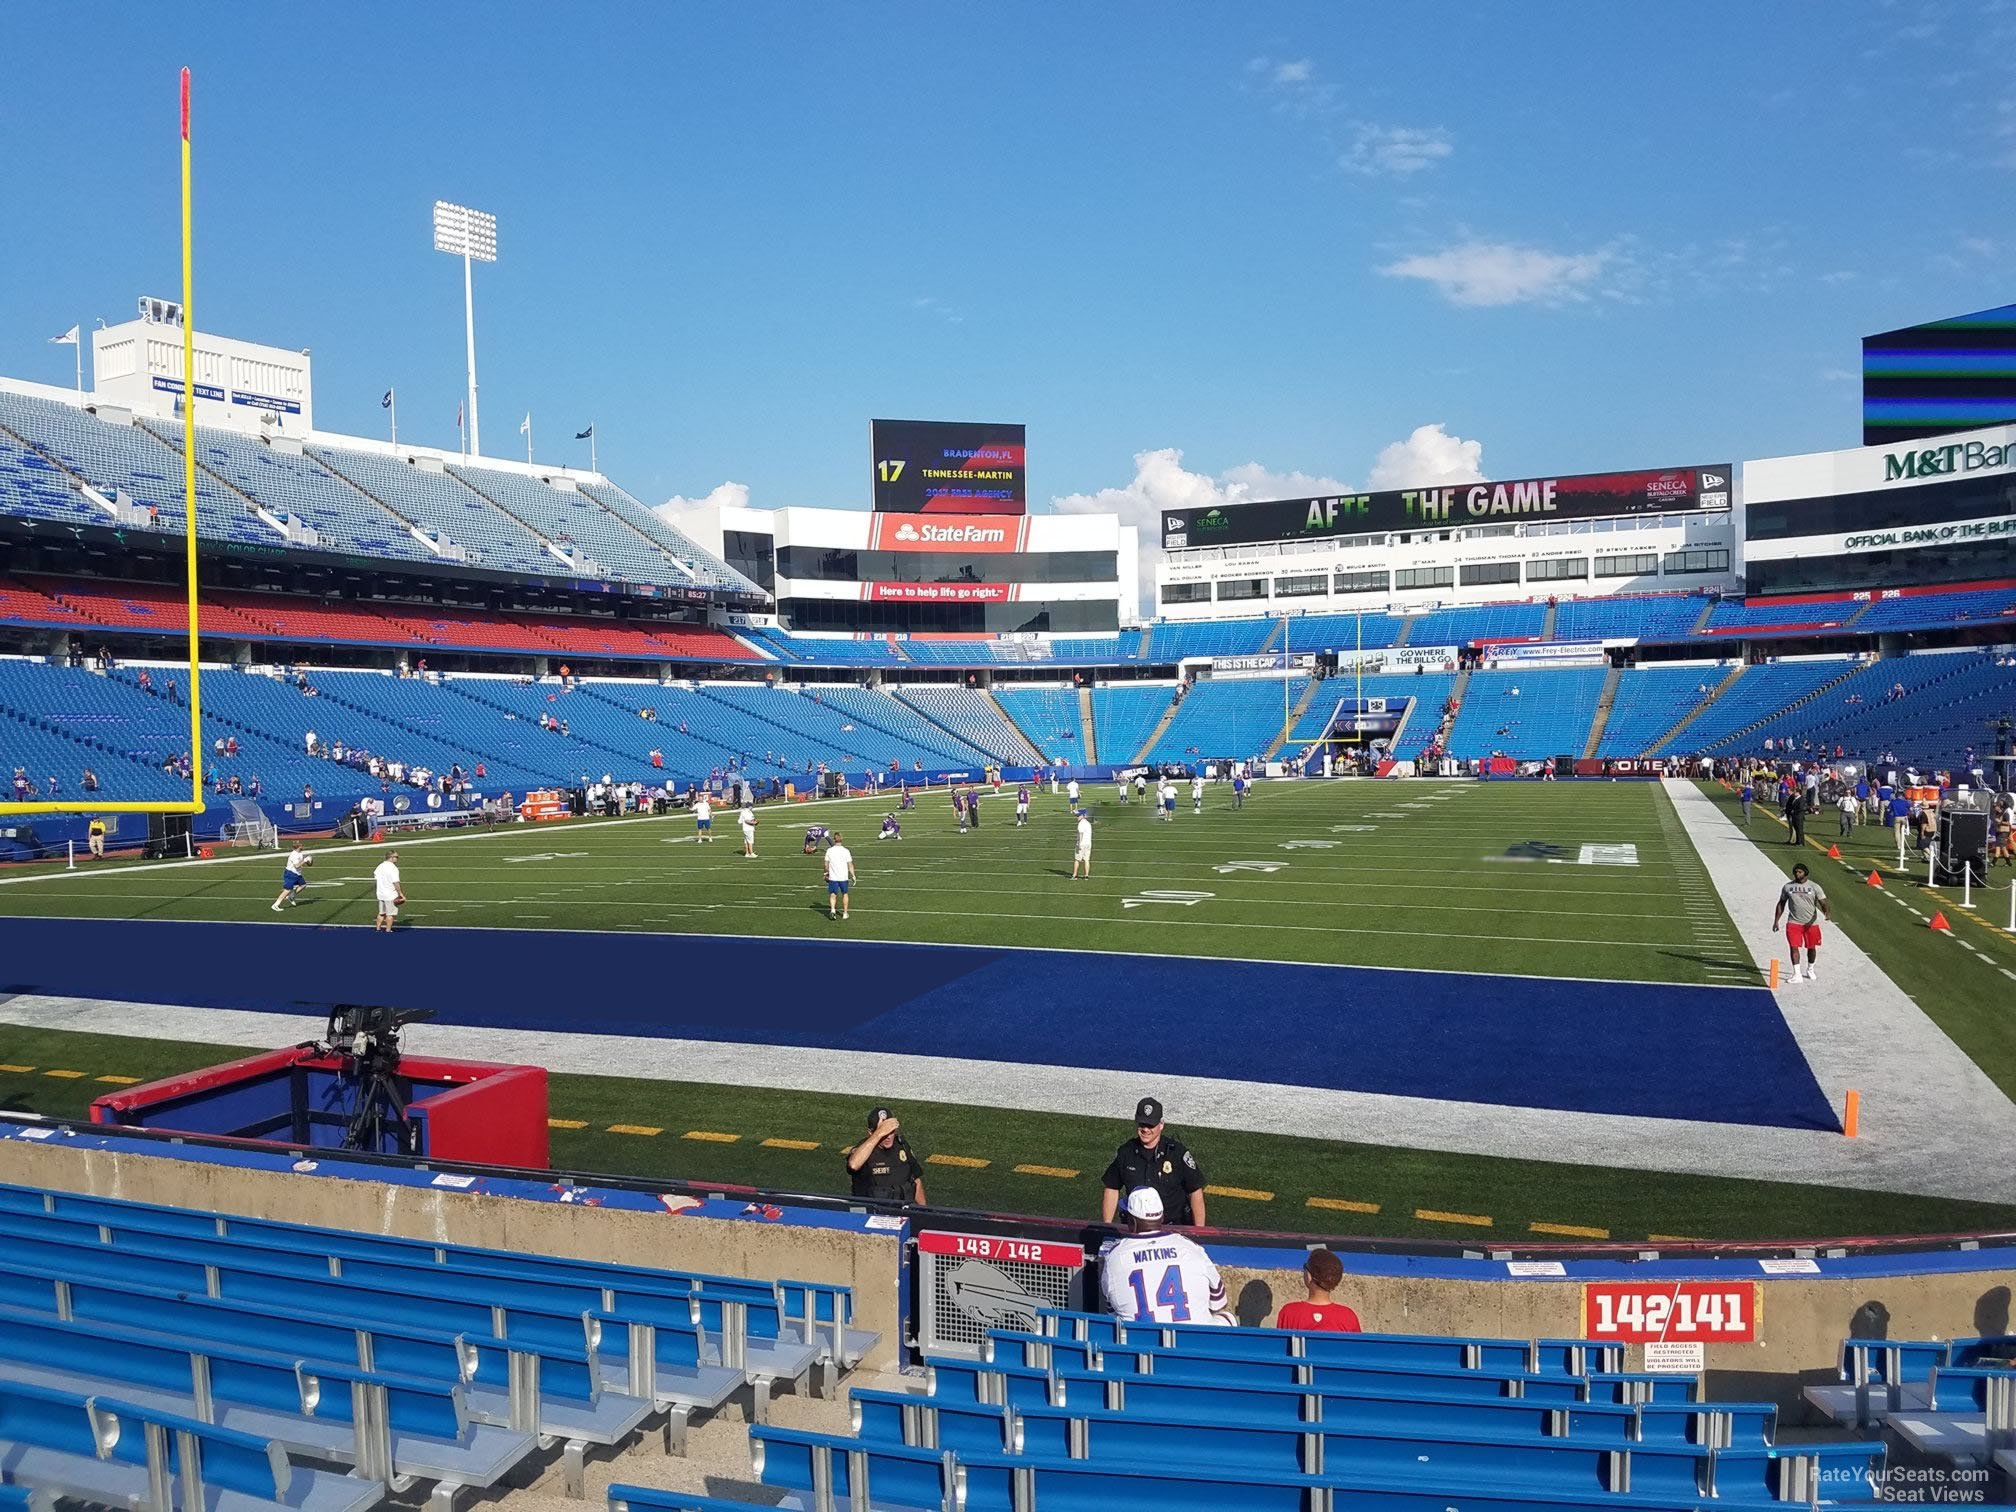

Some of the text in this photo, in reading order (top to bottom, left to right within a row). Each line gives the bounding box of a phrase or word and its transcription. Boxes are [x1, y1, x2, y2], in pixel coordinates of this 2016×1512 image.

[154, 380, 166, 388] FAN
[195, 388, 209, 396] TEXT
[210, 390, 224, 398] LINE
[878, 460, 905, 482] 17
[922, 469, 1013, 480] TENNESSEE-MARTIN
[1646, 480, 1687, 491] SENECA
[1466, 480, 1557, 517] GAME
[1701, 499, 1726, 507] FIELD
[1196, 518, 1229, 527] SENECA
[1845, 532, 1901, 548] OFFICIAL
[1903, 527, 1939, 542] BANK
[1940, 525, 1959, 539] OF
[1959, 522, 1986, 537] THE
[1167, 539, 1186, 547] FIELD
[688, 590, 707, 599] 85:27
[879, 586, 903, 597] Here
[904, 587, 915, 597] to
[917, 587, 938, 599] help
[940, 586, 956, 597] life
[958, 589, 970, 599] go
[1703, 586, 1720, 594] 224
[1853, 591, 1871, 600] 225
[1881, 589, 1900, 599] 226
[733, 616, 745, 624] 217
[1414, 648, 1446, 656] WHERE
[1522, 646, 1603, 656] www.Frey-Electric.com
[1213, 657, 1276, 669] THIS IS THE CAP
[1602, 760, 1663, 771] OME
[956, 1238, 990, 1255] 143
[1008, 1243, 1042, 1260] 142
[1133, 1247, 1178, 1263] WATKINS
[1128, 1265, 1191, 1322] 14
